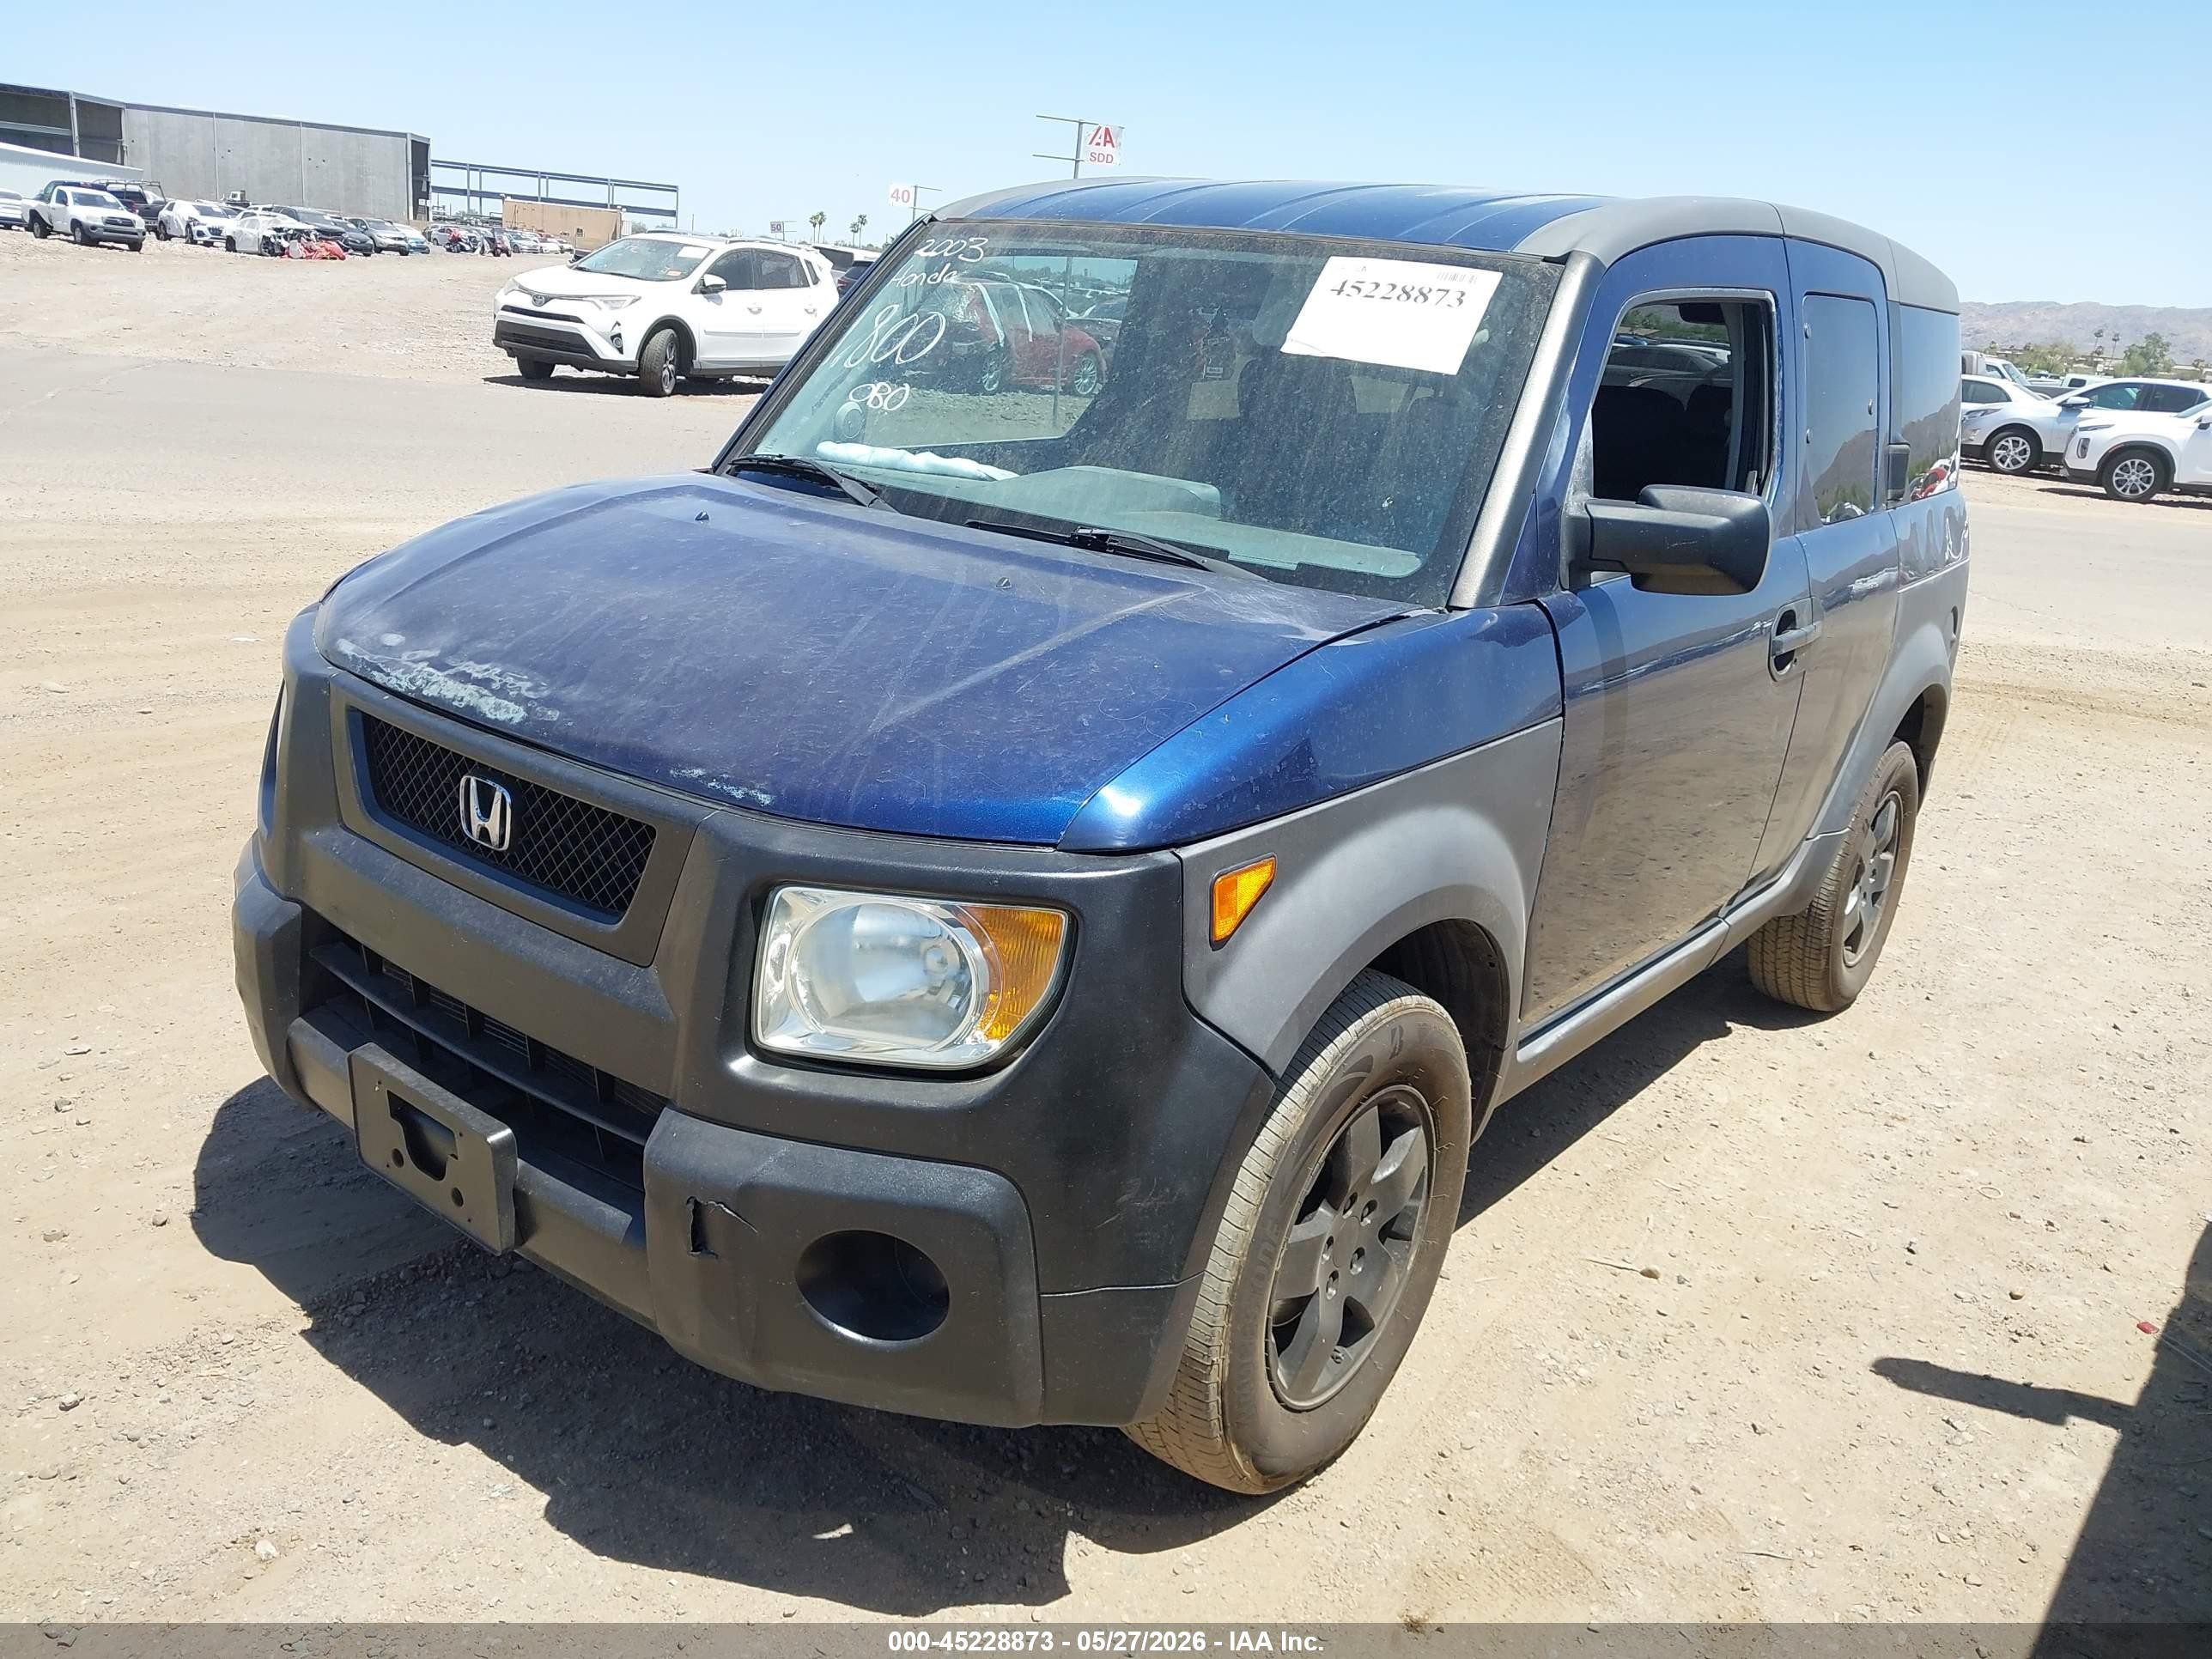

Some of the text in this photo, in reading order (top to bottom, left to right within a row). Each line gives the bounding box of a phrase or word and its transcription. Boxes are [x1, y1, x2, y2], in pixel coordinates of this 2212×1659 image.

[1089, 151, 1114, 164] SDD
[890, 187, 911, 204] 40
[914, 237, 989, 263] 2003
[890, 263, 961, 288] Honda
[1330, 279, 1467, 308] 45228873
